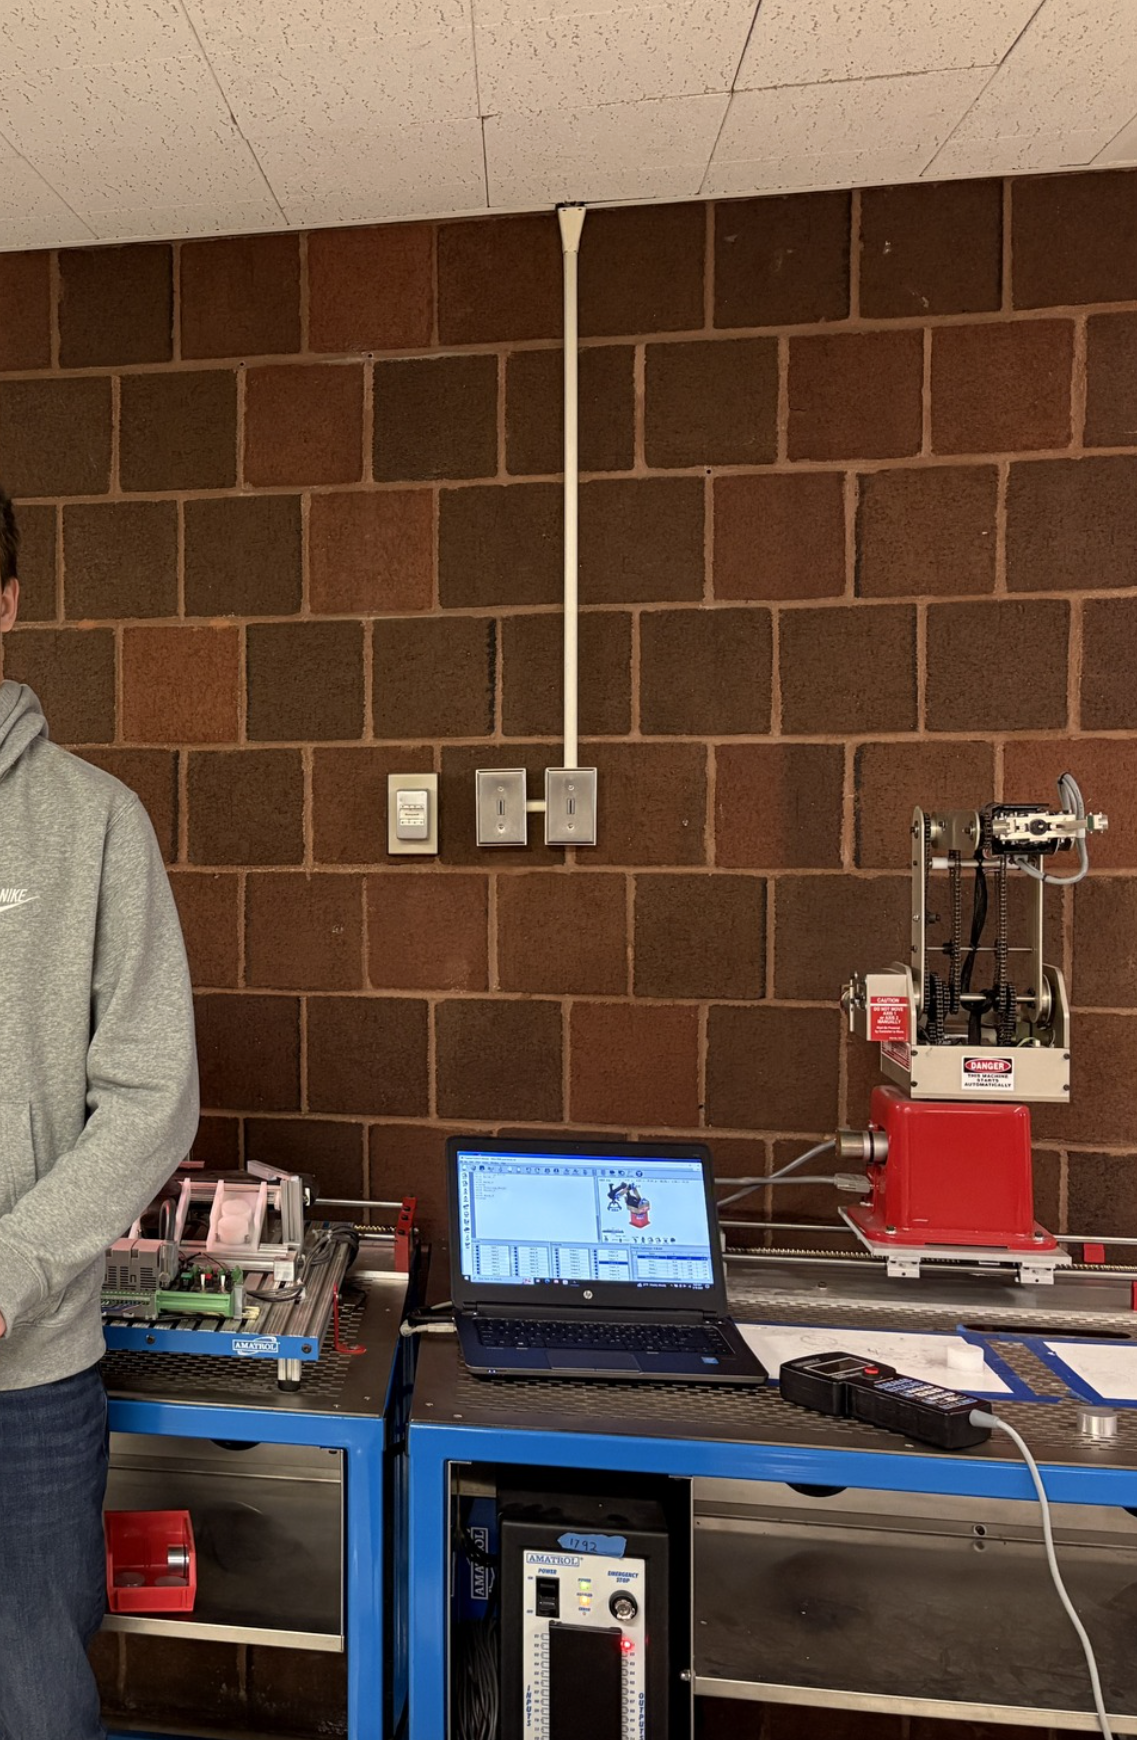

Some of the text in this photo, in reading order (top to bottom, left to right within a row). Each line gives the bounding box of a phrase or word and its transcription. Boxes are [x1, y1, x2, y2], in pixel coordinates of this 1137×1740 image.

[971, 1061, 1005, 1071] DANGER
[235, 1341, 277, 1351] AMATROL
[568, 1538, 598, 1552] 1792
[528, 1554, 579, 1566] AMATROL
[607, 1570, 639, 1579] EMERGENCY
